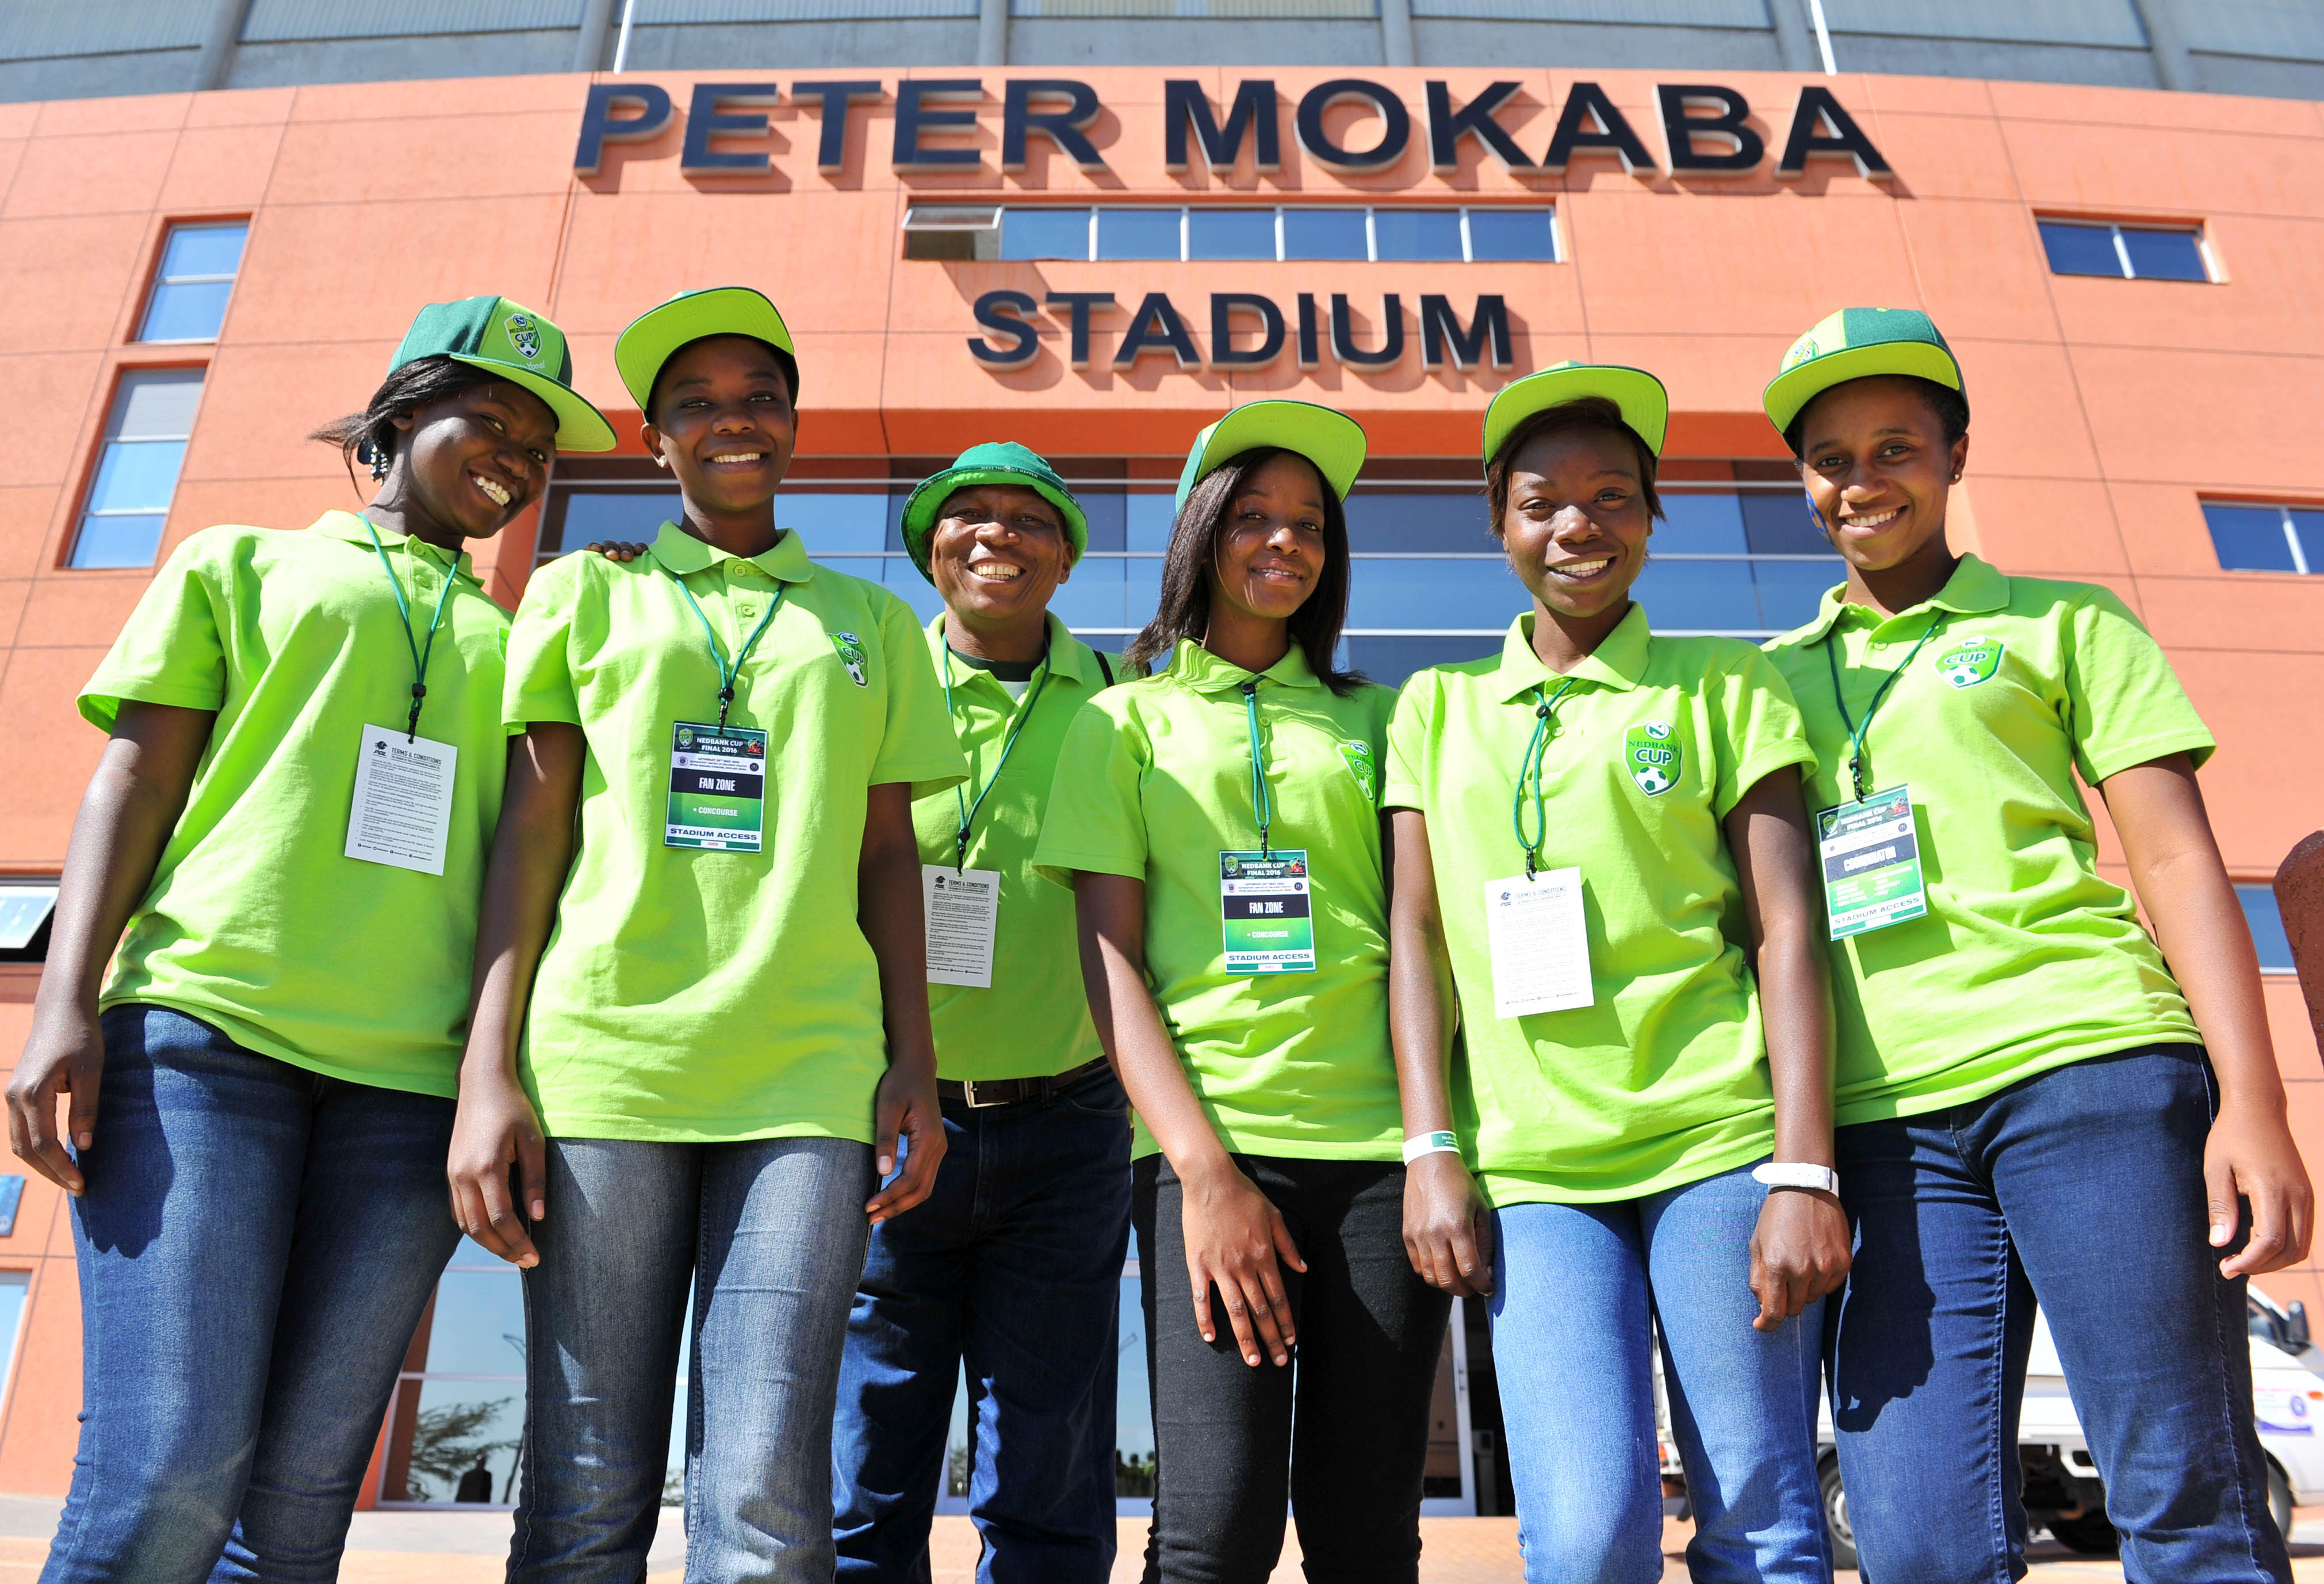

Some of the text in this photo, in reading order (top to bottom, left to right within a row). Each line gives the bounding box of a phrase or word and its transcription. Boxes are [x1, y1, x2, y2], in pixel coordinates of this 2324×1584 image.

[575, 79, 1892, 179] PETER MOKABA
[515, 332, 534, 342] CUP
[967, 290, 1514, 371] STADIUM
[1946, 653, 1986, 663] CUP
[696, 737, 729, 746] NEDBANK
[1628, 740, 1678, 753] NEDBANK
[391, 747, 408, 756] TERMS
[414, 753, 442, 765] CONDITIONS
[1635, 748, 1672, 765] CUP
[699, 777, 736, 791] FAN ZONE
[698, 806, 738, 817] CONCOURSE
[670, 828, 757, 840] STADIUM ACCESS
[1249, 901, 1284, 914] FAN ZONE
[1835, 909, 1877, 924] STADIUM
[1880, 897, 1920, 912] ACCESS
[1251, 930, 1289, 938] CONCOURSE
